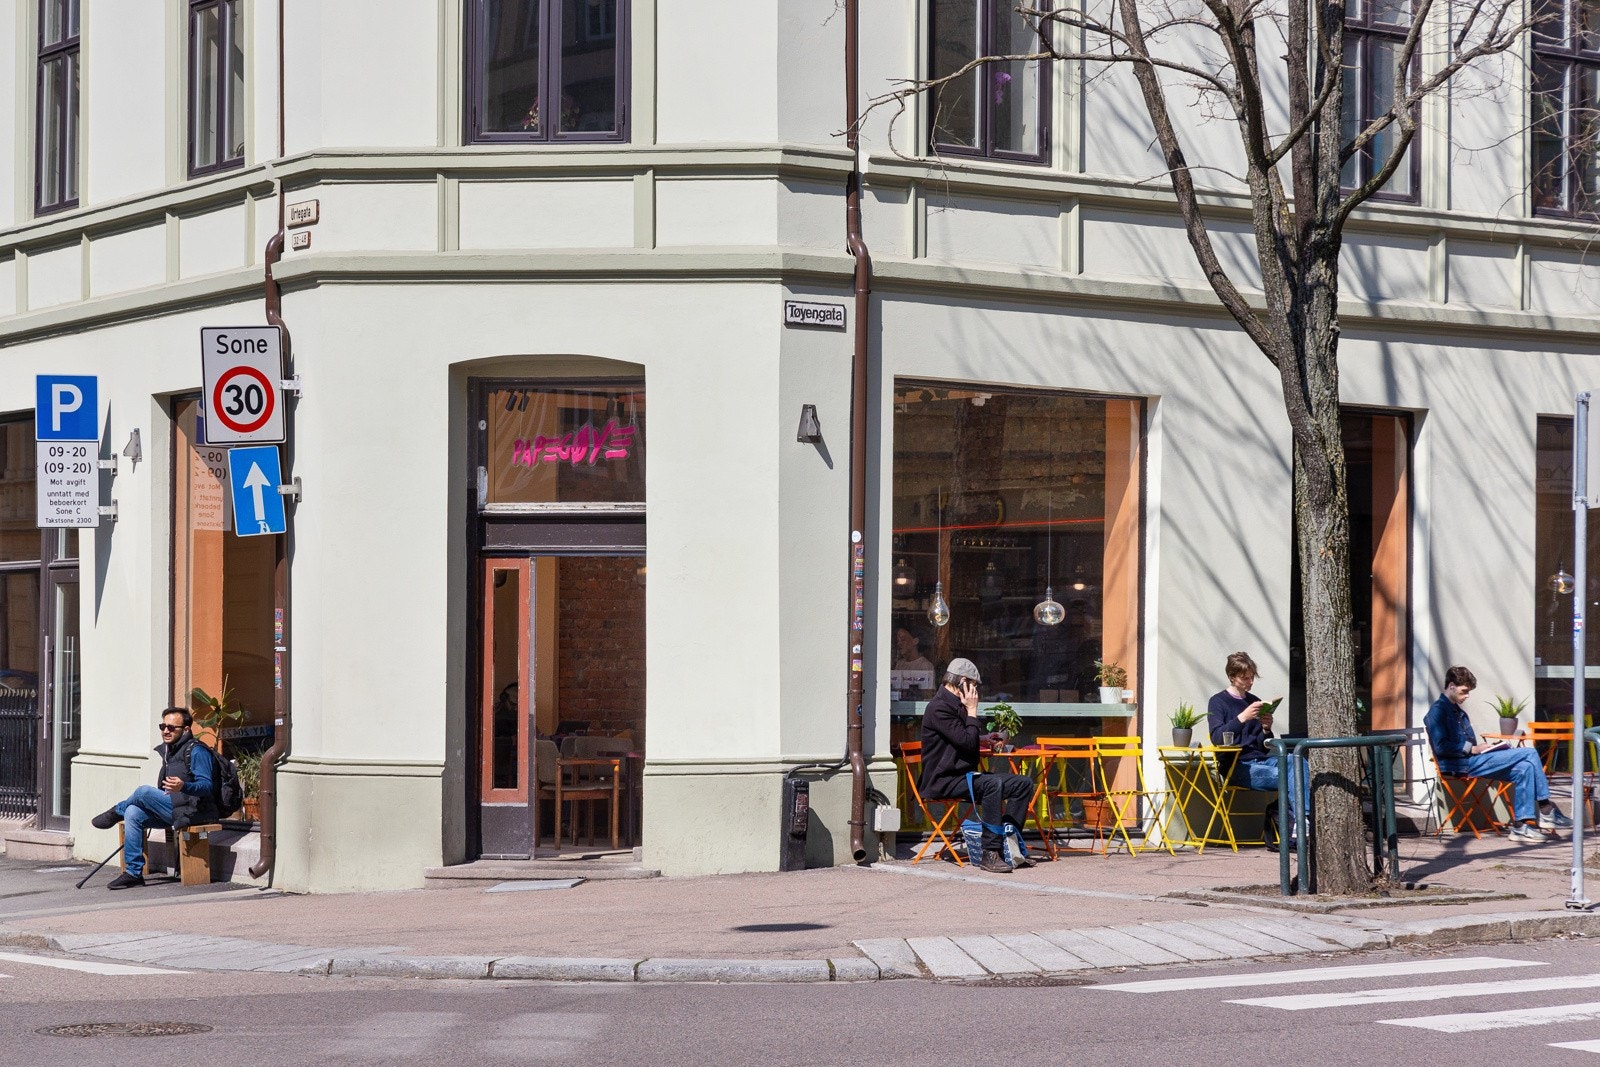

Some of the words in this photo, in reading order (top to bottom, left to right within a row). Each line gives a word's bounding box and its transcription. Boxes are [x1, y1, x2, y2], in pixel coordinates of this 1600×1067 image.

[290, 206, 310, 222] Urtegata
[788, 304, 842, 322] Tøyengata
[216, 334, 268, 354] Sone
[52, 384, 83, 432] P
[224, 384, 264, 416] 30
[66, 478, 86, 487] avgift
